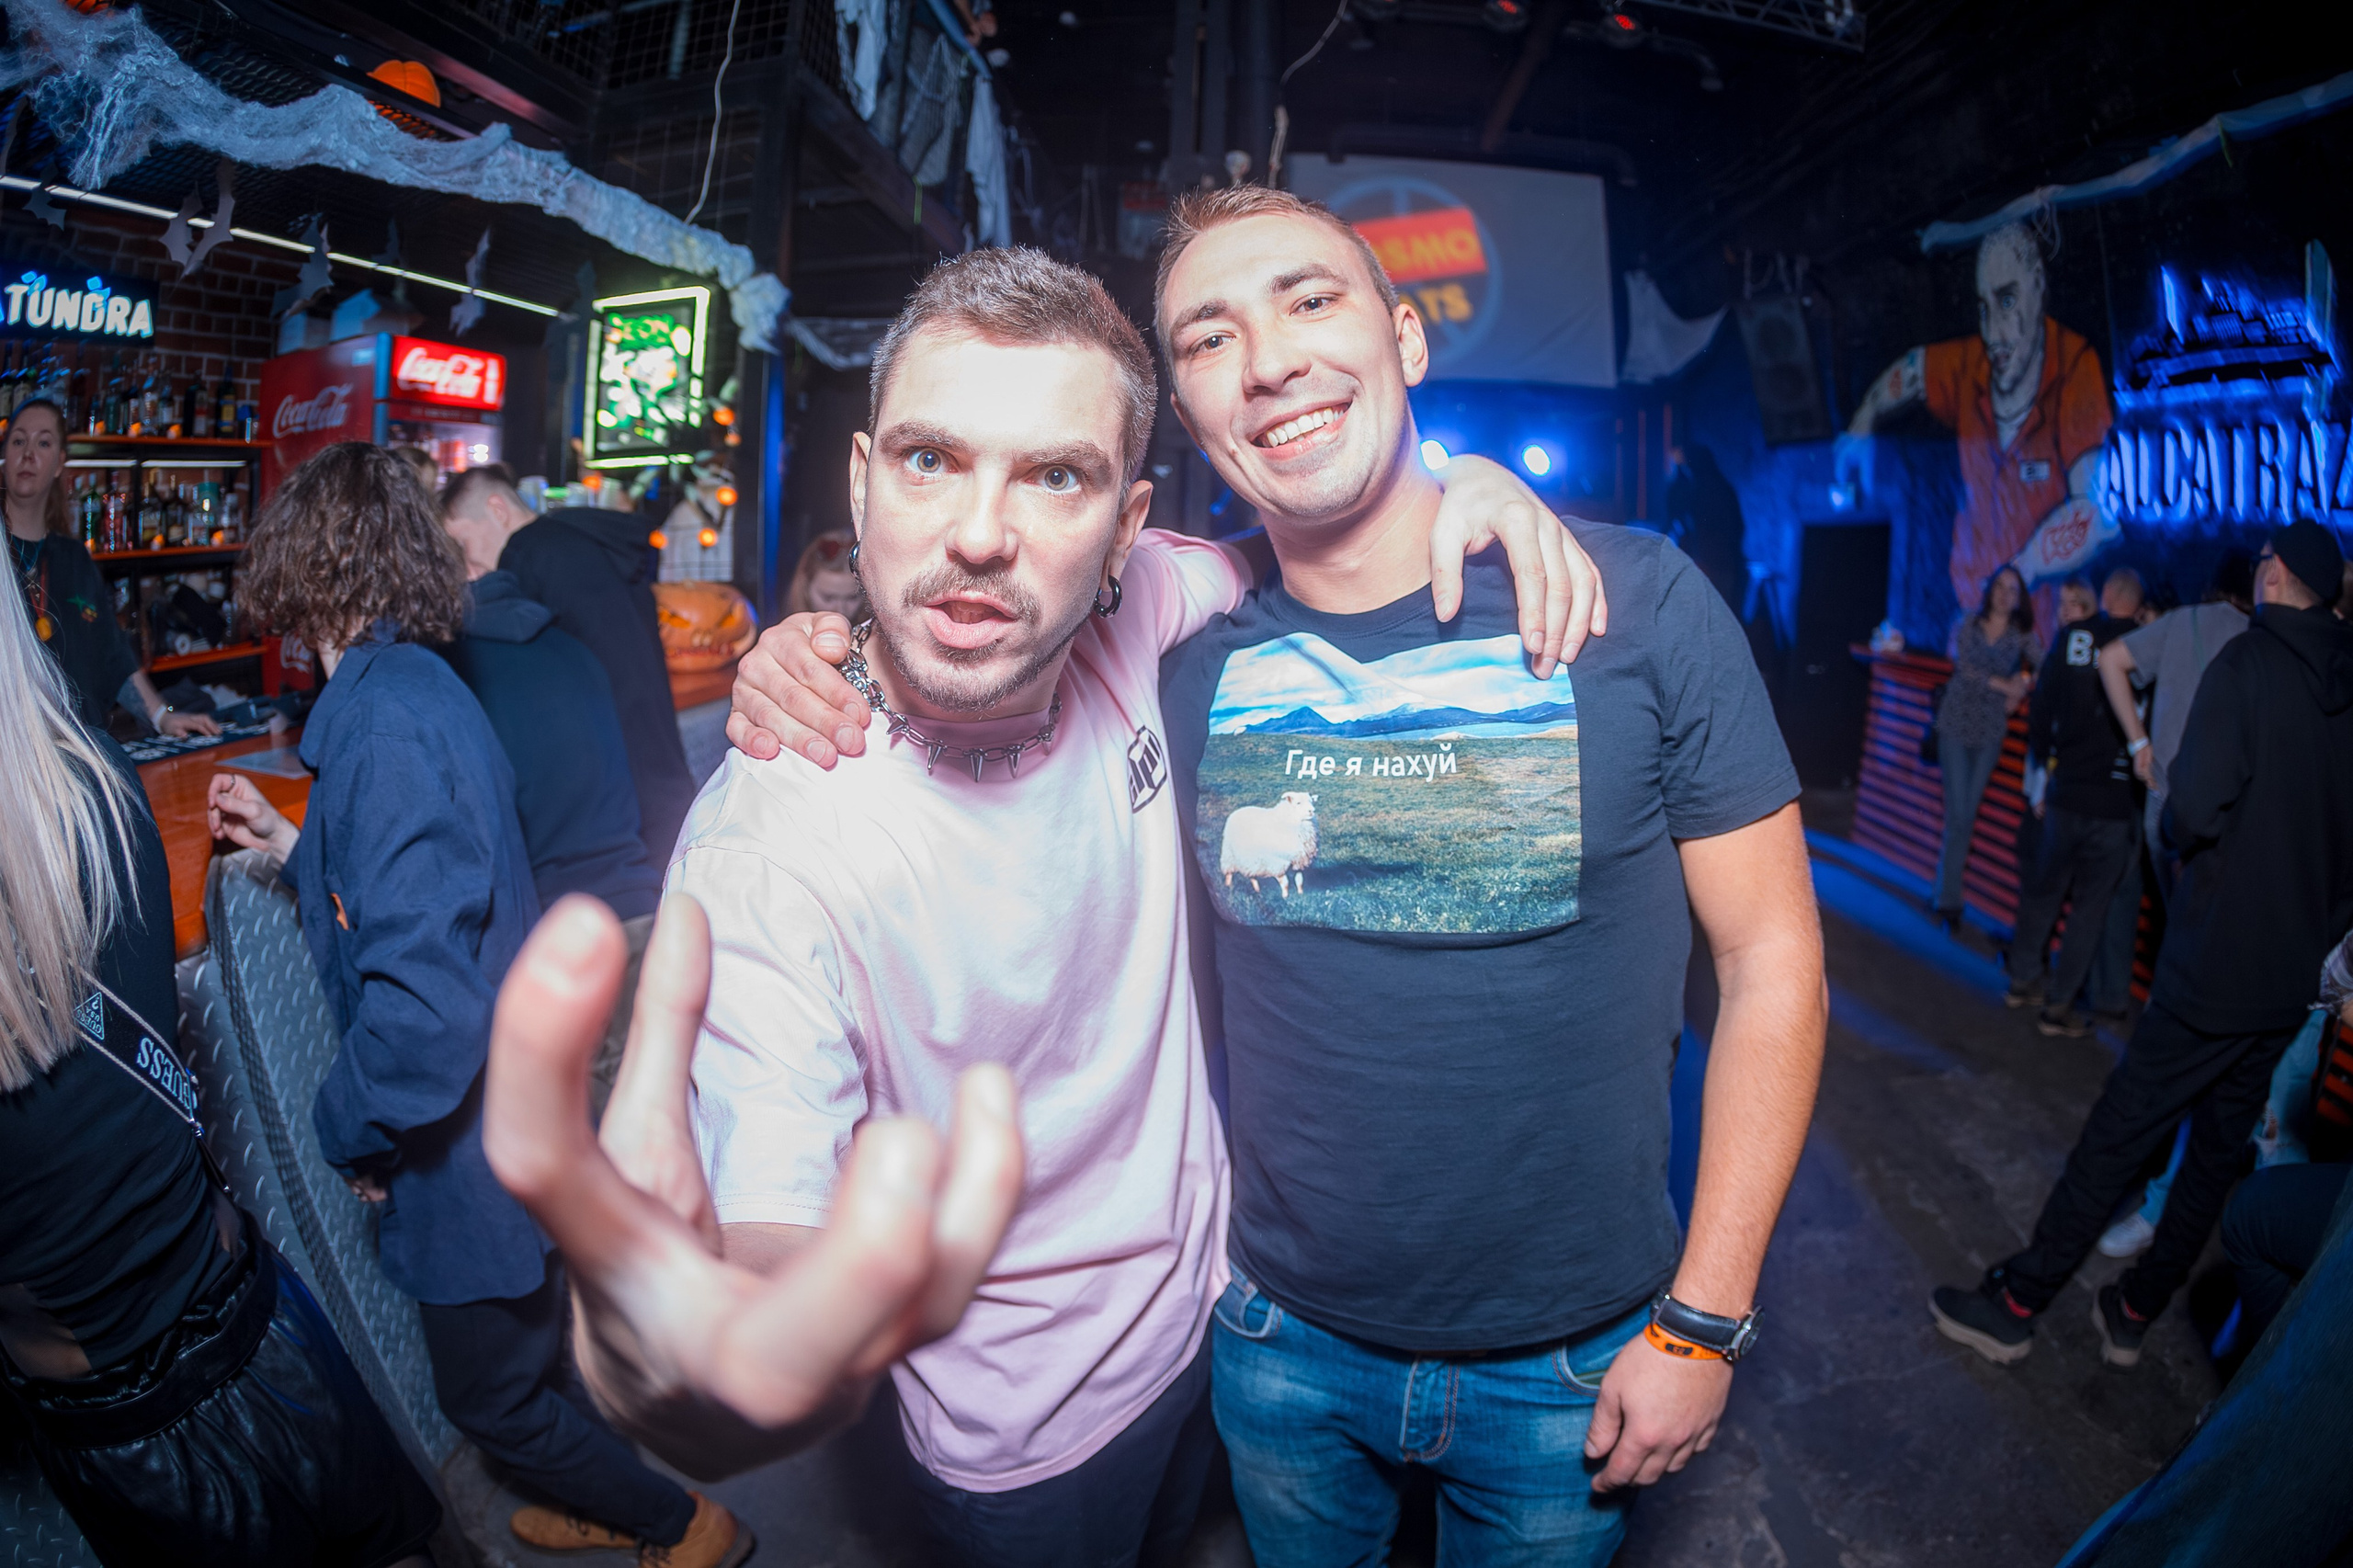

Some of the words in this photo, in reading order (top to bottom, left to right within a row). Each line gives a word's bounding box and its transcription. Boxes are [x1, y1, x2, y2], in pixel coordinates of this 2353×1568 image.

[1373, 229, 1478, 271] SMO
[4, 282, 154, 338] TUNDRA
[1285, 749, 1336, 779] Где
[1345, 756, 1362, 776] я
[1372, 743, 1457, 782] нахуй
[75, 1009, 102, 1034] GUESS
